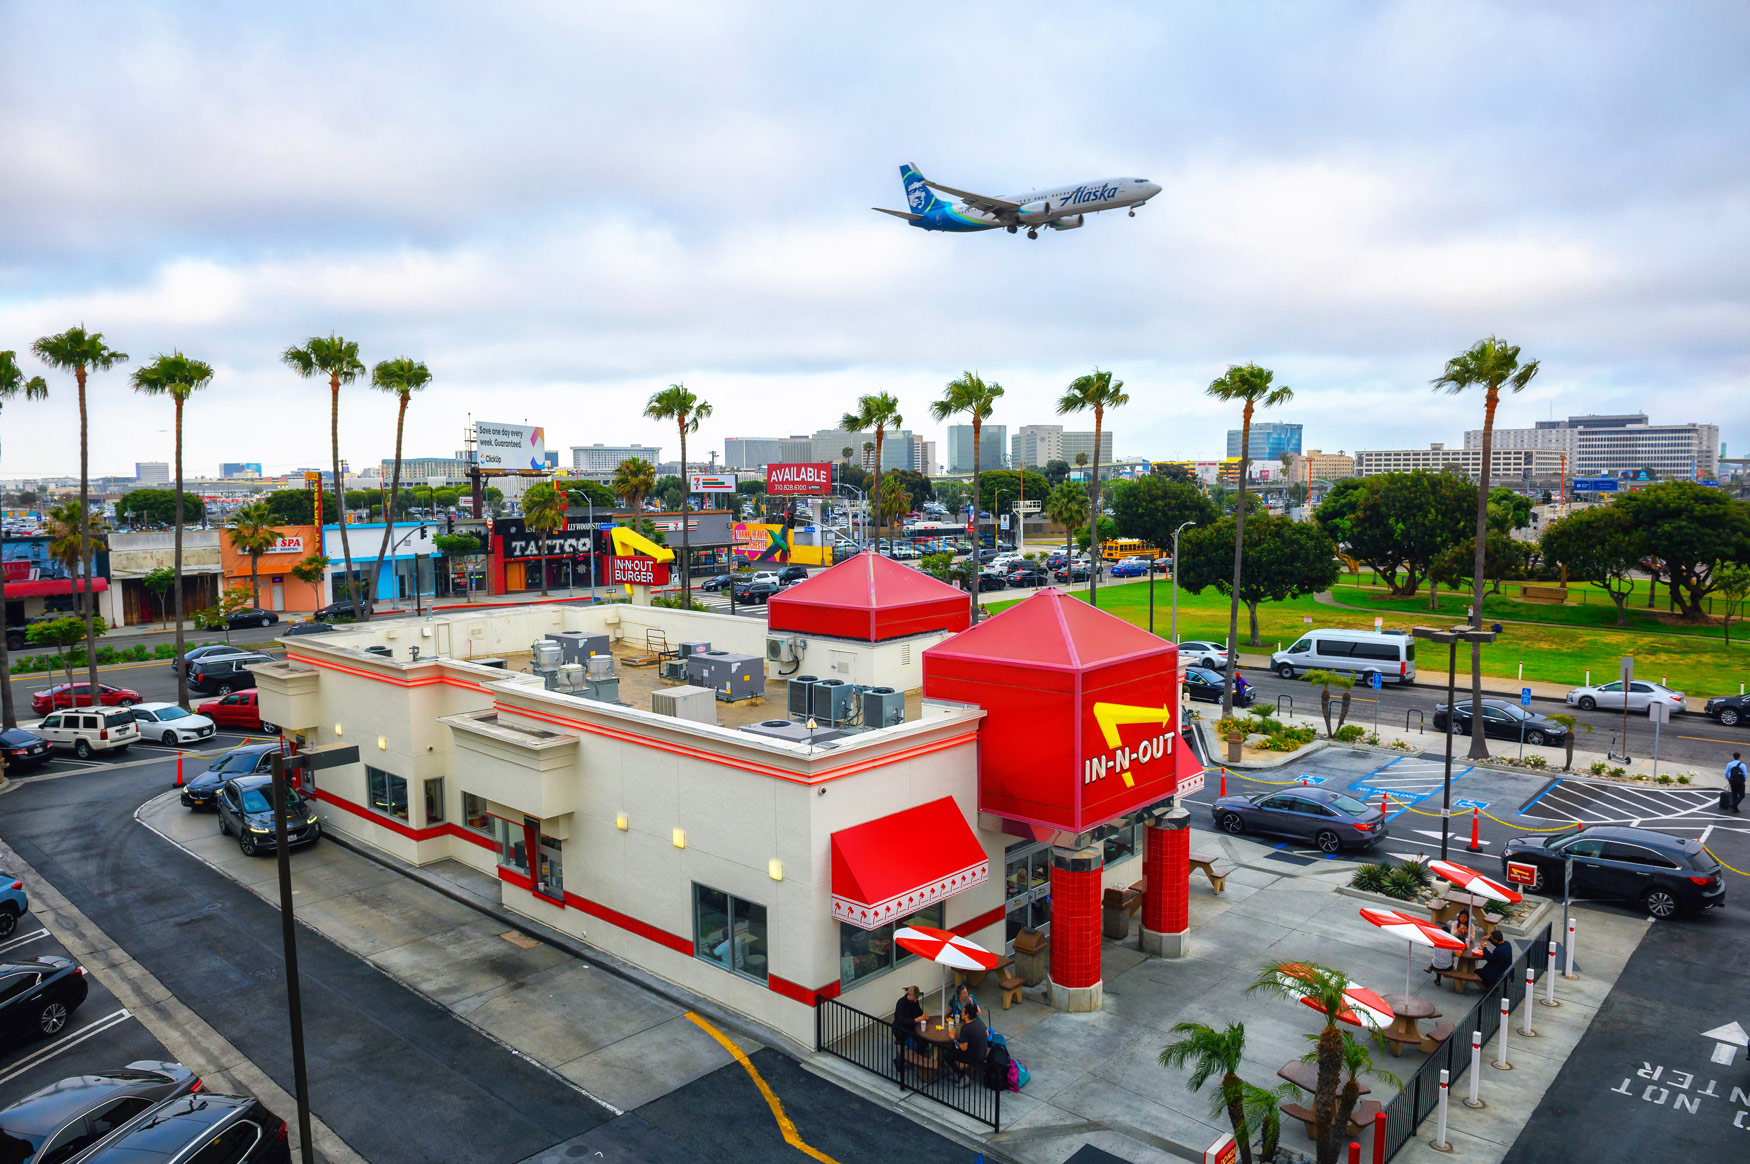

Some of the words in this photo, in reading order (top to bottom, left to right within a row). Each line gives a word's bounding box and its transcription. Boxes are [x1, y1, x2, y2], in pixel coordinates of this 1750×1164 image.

[1059, 182, 1119, 206] Alaska
[480, 426, 491, 435] Save
[492, 428, 501, 436] one
[502, 428, 510, 438] day
[511, 430, 523, 439] every
[480, 439, 494, 447] week.
[494, 439, 522, 448] Guaranteed.
[485, 455, 501, 465] ClickUp
[770, 466, 827, 483] AVAILABLE
[281, 538, 300, 547] SPA
[615, 570, 654, 583] BURGER
[1085, 731, 1175, 785] IN-N-OUT
[1373, 789, 1418, 800] PARKING
[1637, 1061, 1750, 1108] NTER
[1610, 1077, 1702, 1115] NOT
